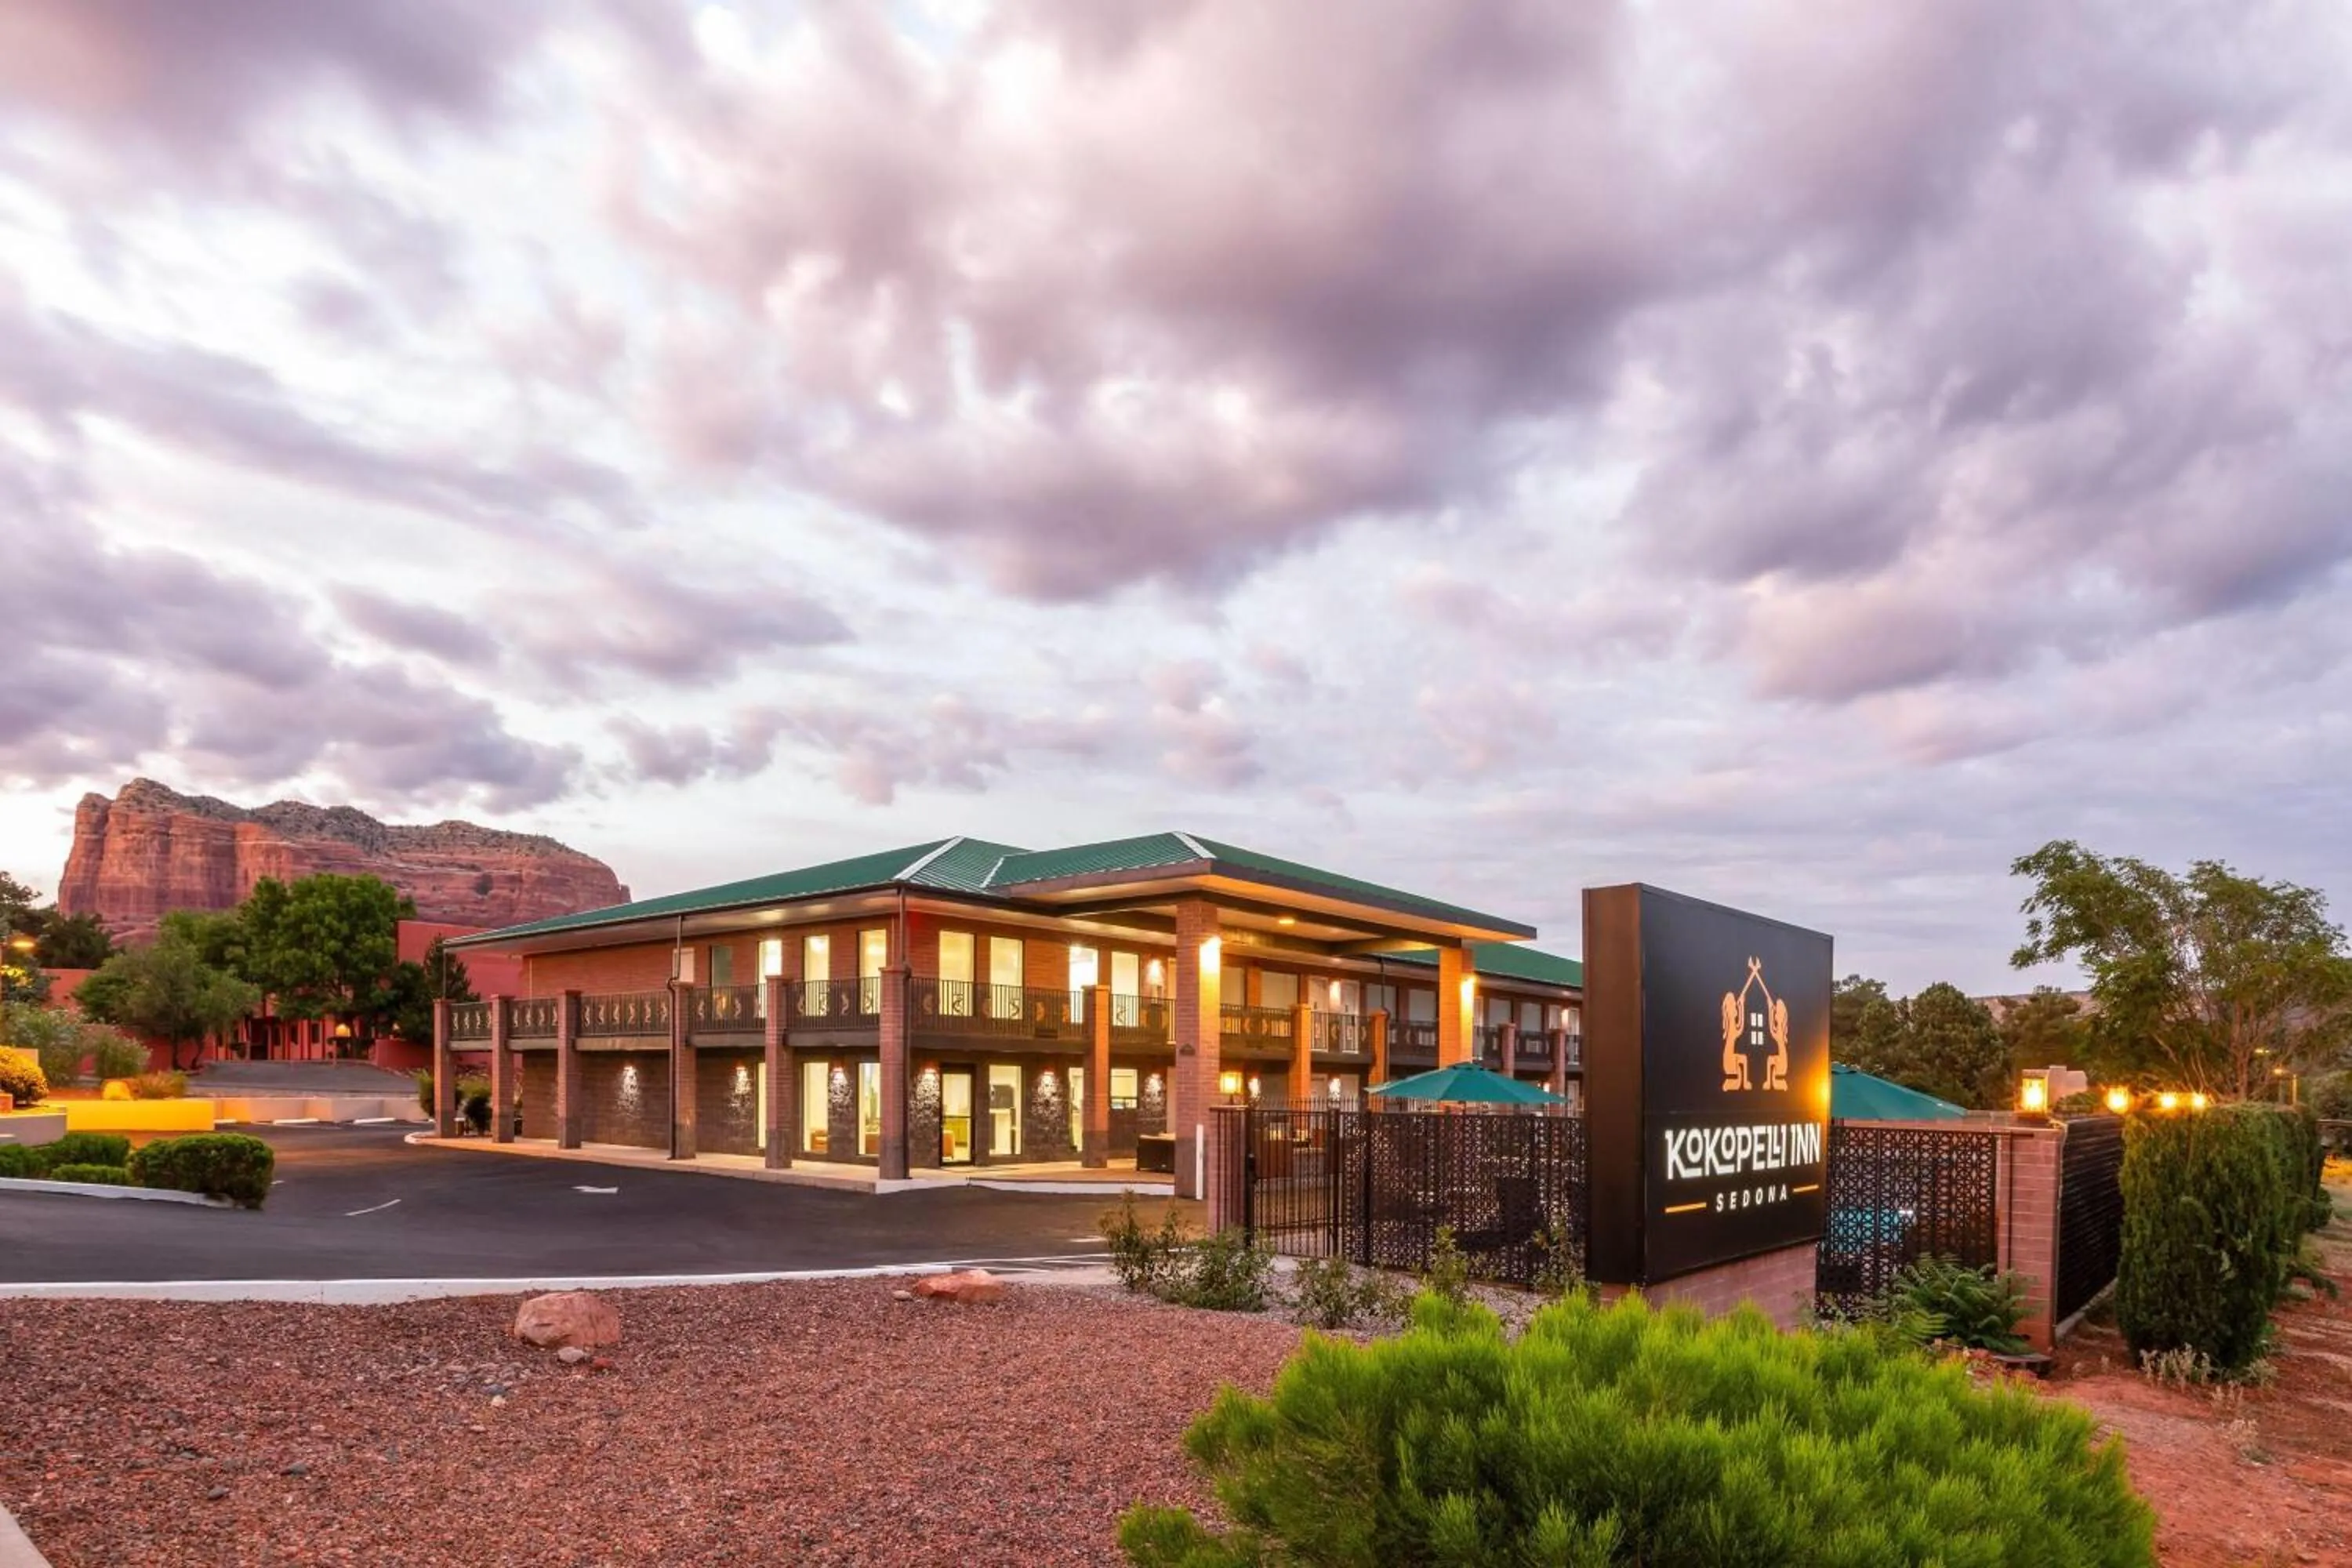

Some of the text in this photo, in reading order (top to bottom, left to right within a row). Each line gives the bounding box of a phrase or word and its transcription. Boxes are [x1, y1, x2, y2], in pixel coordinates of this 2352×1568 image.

[1664, 1123, 1820, 1180] KOKOPELLI INN
[1716, 1184, 1788, 1212] SEDONA
